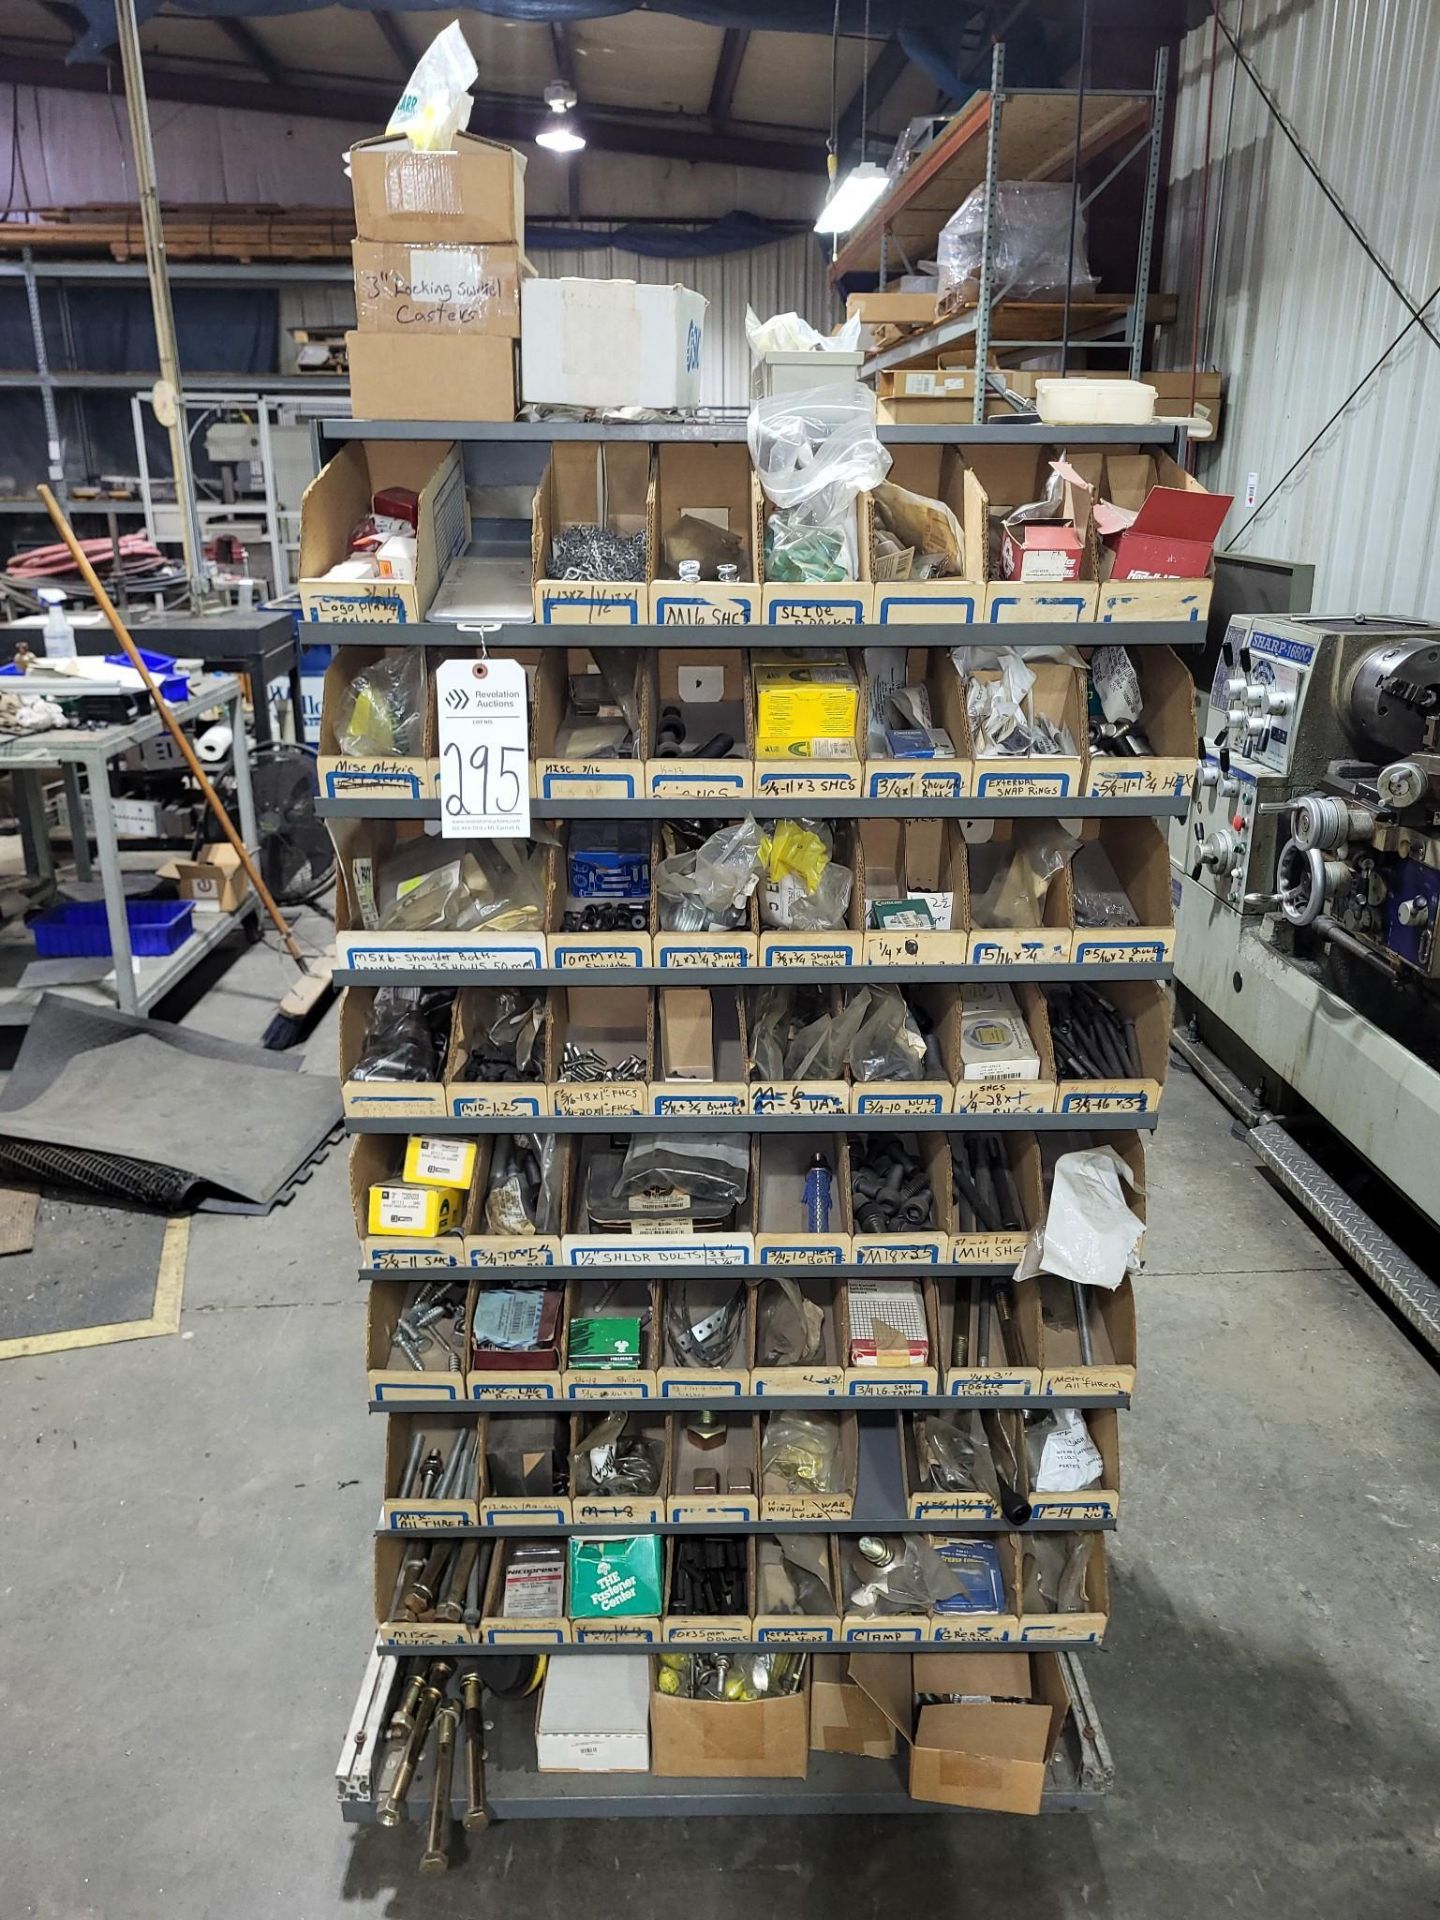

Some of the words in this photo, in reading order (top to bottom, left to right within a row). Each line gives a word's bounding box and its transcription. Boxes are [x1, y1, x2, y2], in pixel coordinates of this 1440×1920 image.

[366, 271, 388, 299] 3"
[394, 280, 453, 302] Locking
[396, 303, 477, 324] Casters
[475, 690, 520, 698] Revelation
[477, 700, 515, 708] Auctions
[443, 742, 526, 817] 295
[590, 1575, 637, 1605] Fastener
[597, 1571, 621, 1590] THE
[600, 1587, 637, 1611] Center
